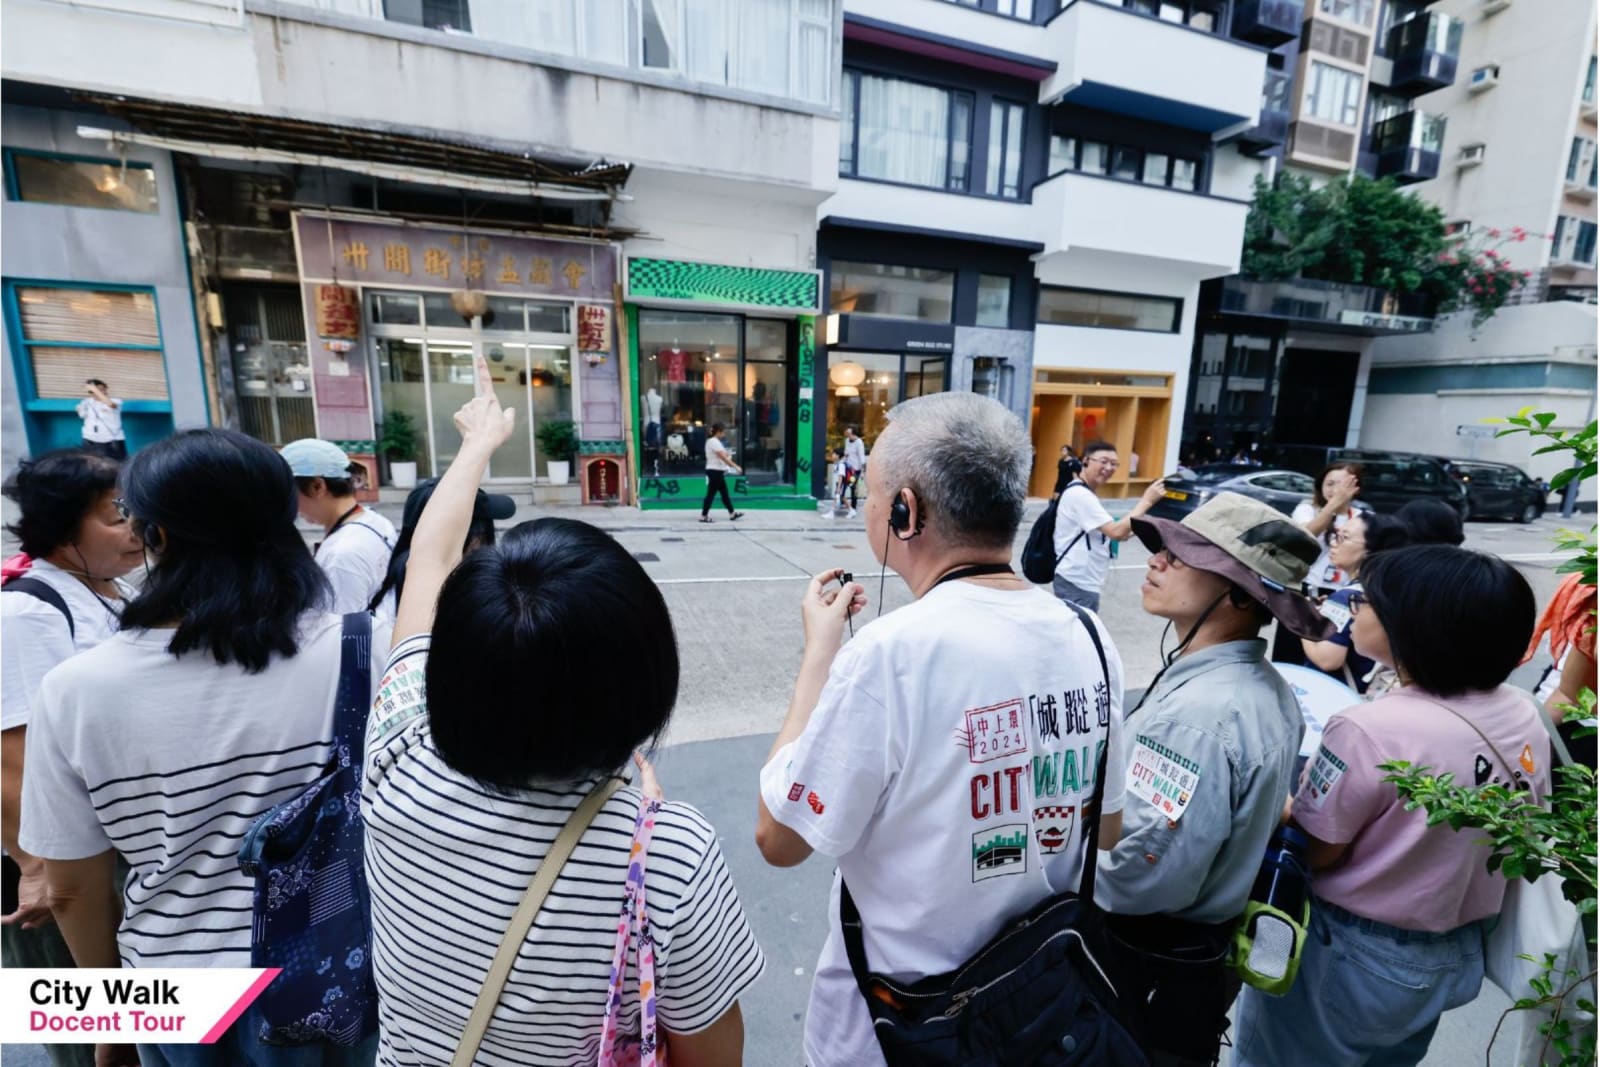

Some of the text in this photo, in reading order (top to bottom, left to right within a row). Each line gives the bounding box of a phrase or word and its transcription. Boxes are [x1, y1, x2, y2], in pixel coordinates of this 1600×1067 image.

[977, 709, 1019, 737] 中上環
[979, 733, 1021, 755] 2024
